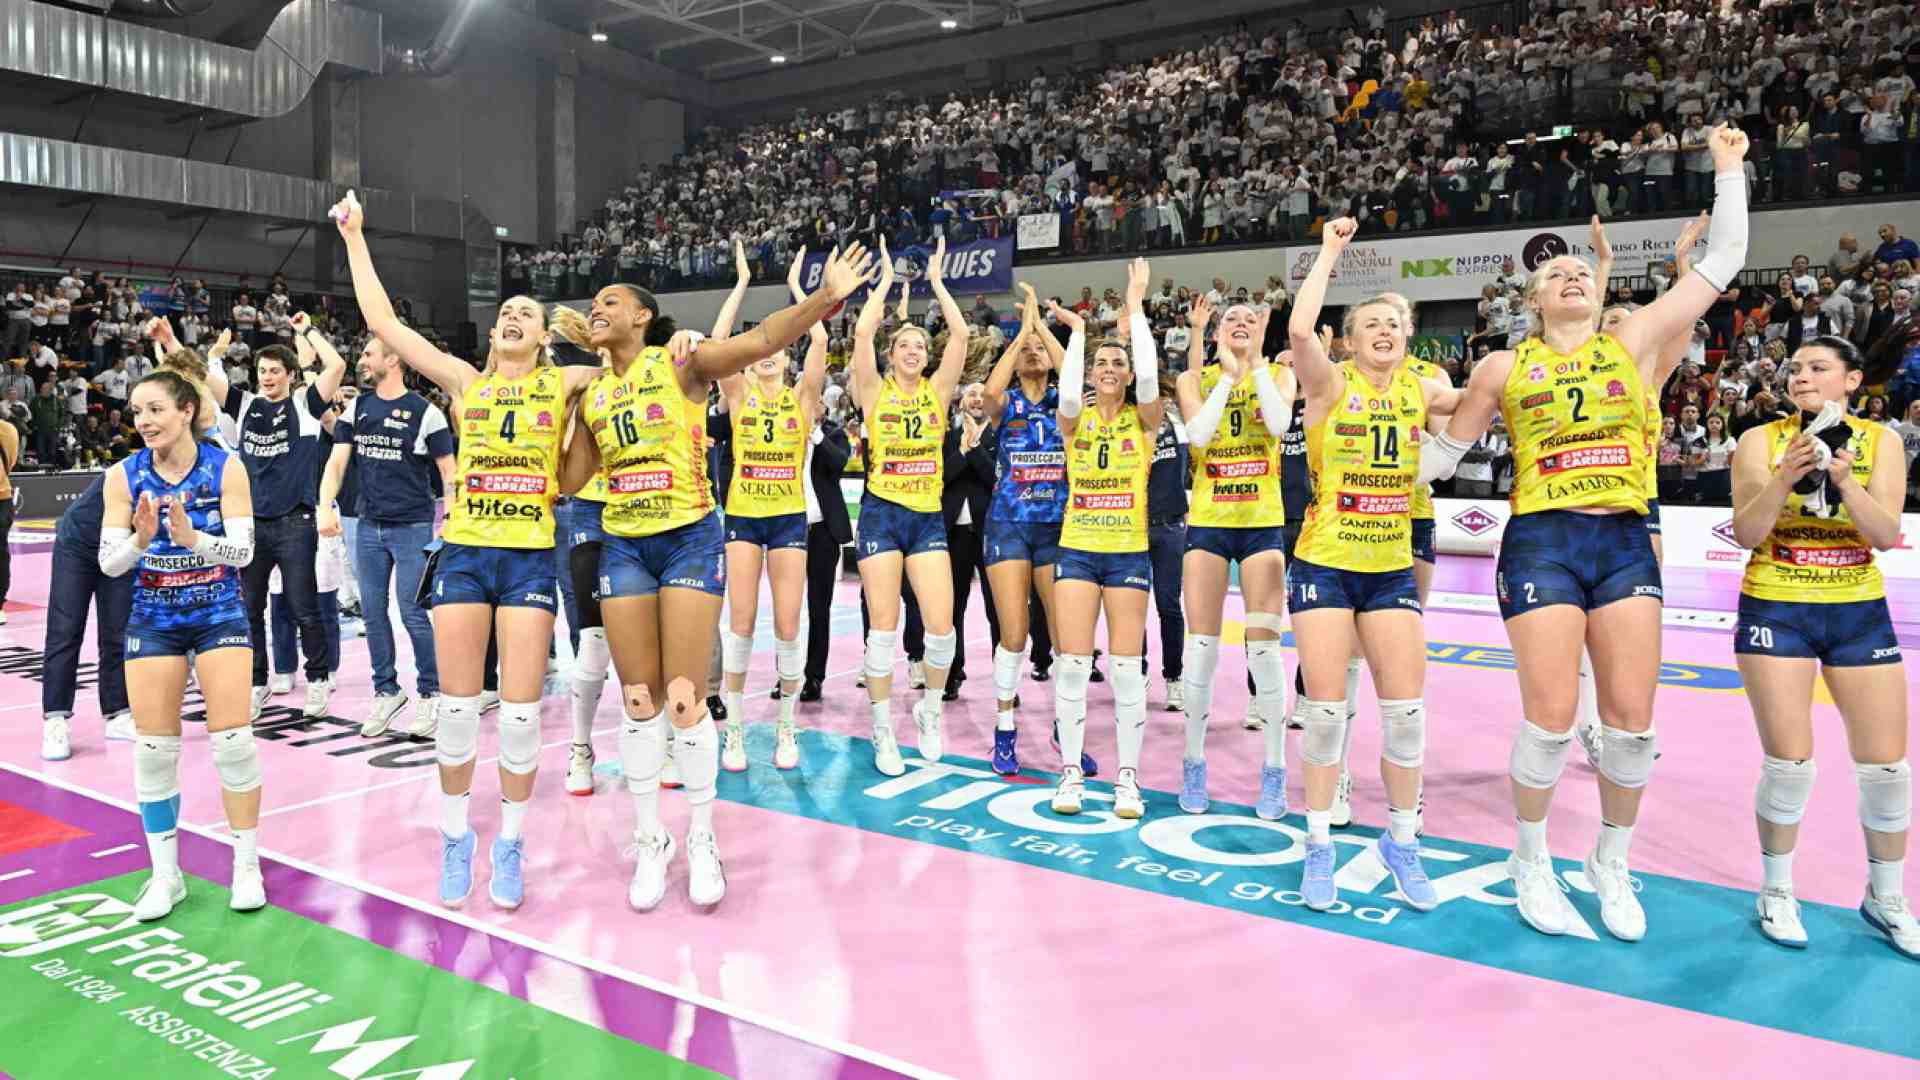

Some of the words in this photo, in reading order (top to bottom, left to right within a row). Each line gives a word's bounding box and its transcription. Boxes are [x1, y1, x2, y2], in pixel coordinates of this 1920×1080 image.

[1456, 254, 1513, 266] NIPPON
[1456, 265, 1506, 276] EXPRES
[1567, 387, 1589, 422] 2
[500, 410, 515, 443] 4
[611, 409, 639, 449] 16
[763, 419, 774, 443] 3
[903, 415, 922, 440] 12
[1035, 421, 1044, 445] 1
[1230, 409, 1242, 437] 9
[1370, 425, 1399, 462] 14
[1562, 448, 1626, 459] ANTONIO
[470, 454, 528, 468] PROSECCO
[1097, 443, 1109, 470] 6
[1561, 455, 1627, 468] CARRARO
[485, 476, 545, 484] ANTONIO
[1075, 478, 1118, 489] PROSECCO
[1343, 472, 1402, 488] PROSECCO
[1340, 518, 1393, 528] CANTINA
[866, 542, 878, 554] 12
[144, 554, 205, 569] PROSECCO
[1300, 584, 1317, 602] 14
[1524, 583, 1538, 603] 2
[1750, 626, 1773, 648] 20
[896, 814, 1005, 842] play
[1010, 834, 1098, 865] fair,
[1115, 856, 1223, 887] feel
[88, 927, 334, 1030] Fratelli
[31, 958, 75, 983] Dal
[63, 972, 129, 1004] 1924
[118, 1004, 278, 1080] ASSISTENZA
